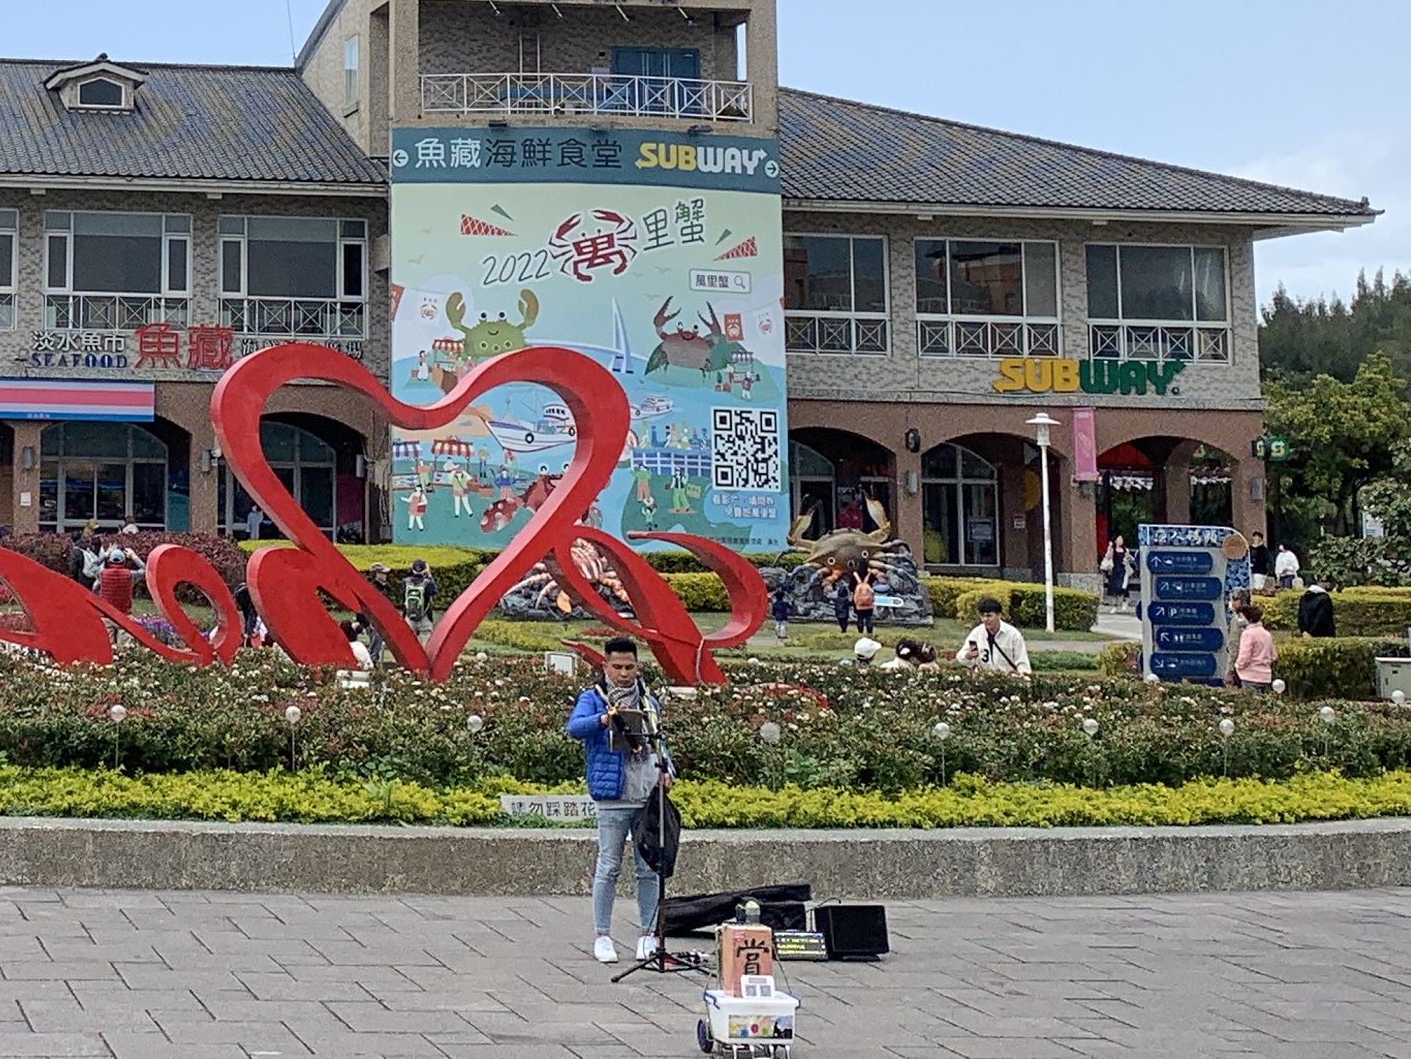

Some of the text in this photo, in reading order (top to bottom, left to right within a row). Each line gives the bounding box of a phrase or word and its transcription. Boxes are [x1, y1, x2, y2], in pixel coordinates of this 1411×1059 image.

[414, 137, 622, 169] 魚藏海鮮食堂
[635, 143, 768, 175] SUBWAY
[483, 250, 550, 285] 2022
[32, 331, 127, 352] 淡水魚市
[135, 323, 234, 370] 魚藏
[31, 352, 128, 369] SEAFOOD
[992, 357, 1186, 396] SUBWAY
[981, 648, 990, 663] 3
